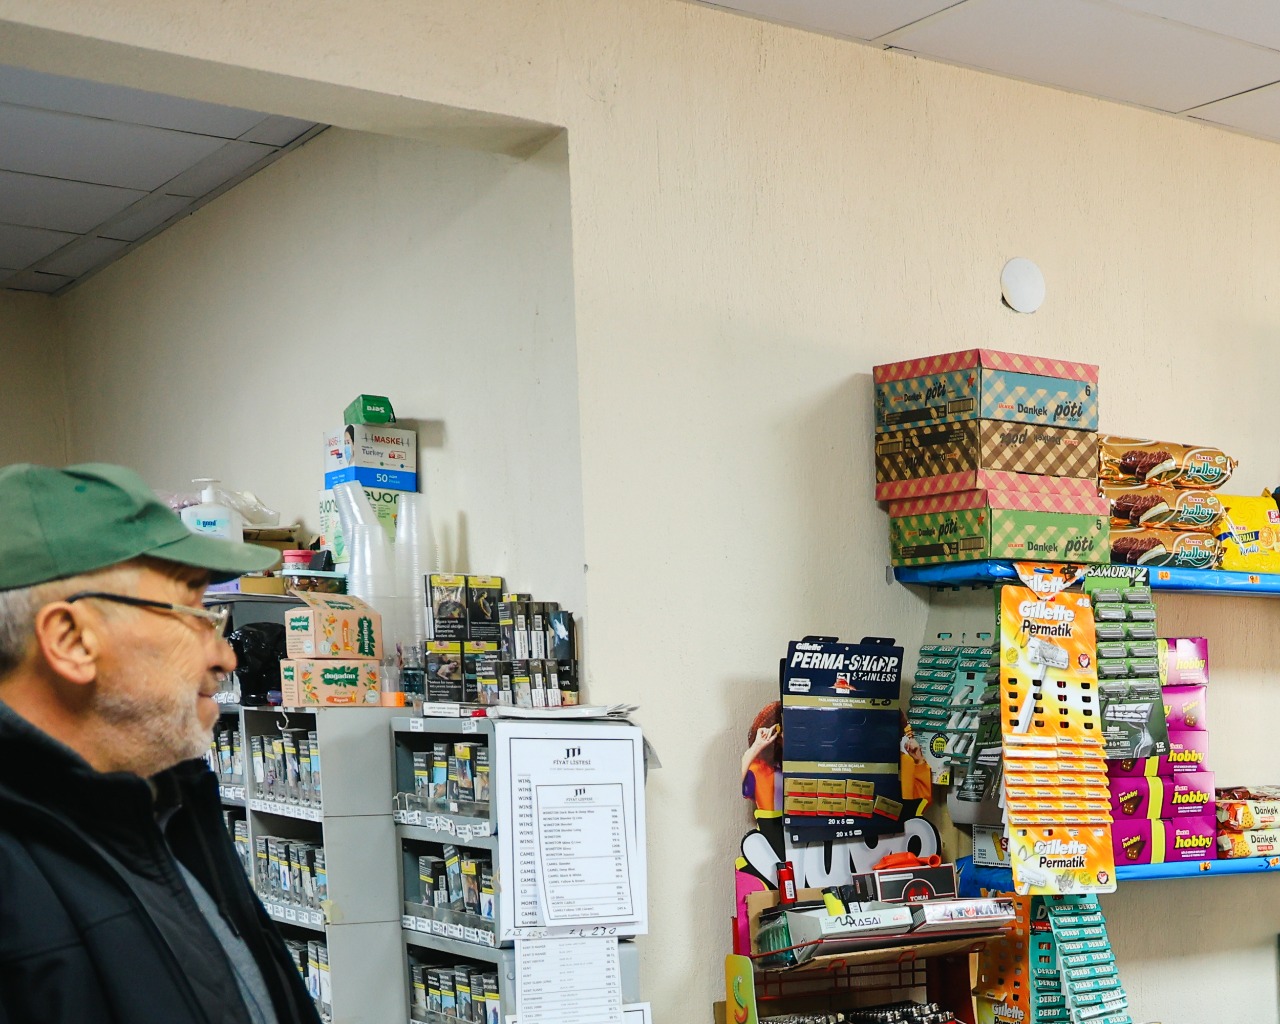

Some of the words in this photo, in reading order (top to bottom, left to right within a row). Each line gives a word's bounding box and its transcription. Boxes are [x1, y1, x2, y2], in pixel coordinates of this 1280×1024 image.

[1085, 385, 1091, 397] 6
[1017, 403, 1048, 416] Dankek
[1053, 400, 1084, 418] pöti
[374, 435, 401, 446] MASKE
[362, 448, 384, 458] Turkey
[376, 473, 388, 483] 50
[1189, 461, 1222, 481] halley
[1181, 504, 1214, 523] halley
[1096, 519, 1102, 531] 5
[1027, 542, 1058, 553] Dankek
[1064, 535, 1094, 556] pöti
[1179, 546, 1211, 566] halley
[1087, 566, 1137, 578] SAMURAI
[1135, 566, 1149, 583] 2
[1077, 598, 1091, 608] 48
[1018, 602, 1076, 622] Gillette
[1022, 619, 1072, 638] Permatik
[1176, 657, 1206, 671] hobby
[1155, 742, 1165, 750] 12
[1168, 750, 1204, 764] hobby
[1172, 790, 1210, 805] hobby
[1253, 805, 1279, 816] Dankek
[1122, 834, 1141, 848] hobby
[1175, 835, 1213, 850] hobby
[1250, 834, 1278, 845] Dankek
[1034, 840, 1088, 856] Gillette
[1039, 856, 1085, 869] Permatik
[957, 902, 999, 917] TOKAI
[1091, 953, 1111, 961] DERBY
[1075, 981, 1094, 989] DERBY
[1098, 979, 1118, 987] DERBY
[1039, 995, 1061, 1003] DERBY
[992, 1002, 1024, 1021] Gillette
[1038, 1009, 1061, 1017] DERBY
